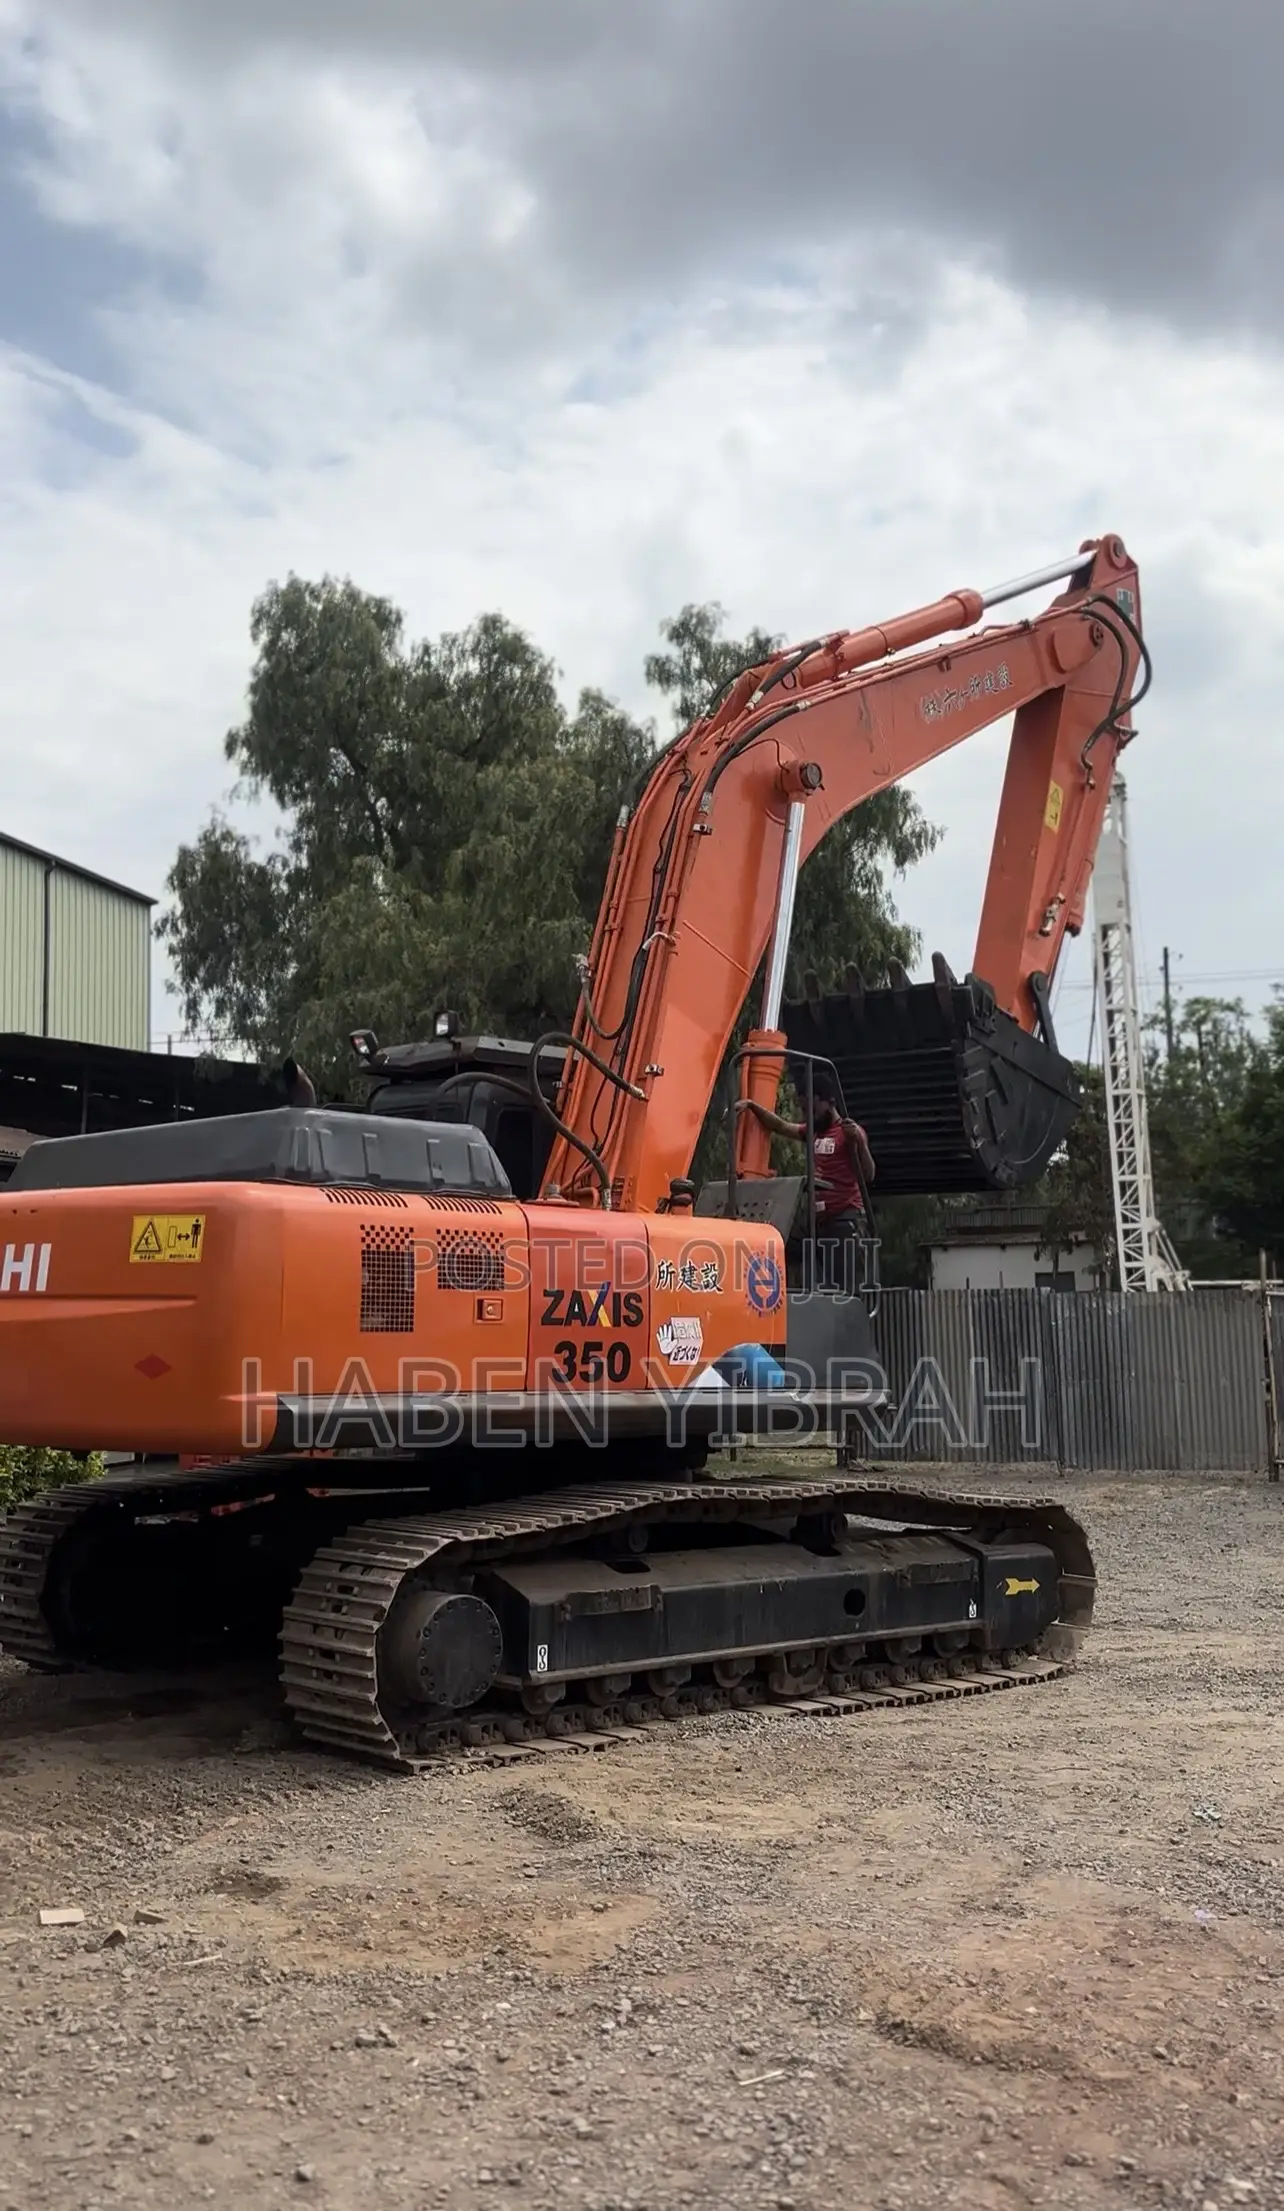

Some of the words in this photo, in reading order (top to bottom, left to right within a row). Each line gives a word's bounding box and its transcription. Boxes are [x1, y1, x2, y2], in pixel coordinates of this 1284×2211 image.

[1, 1243, 52, 1292] HI
[541, 1281, 644, 1328] ZAXIS
[551, 1340, 632, 1383] 350
